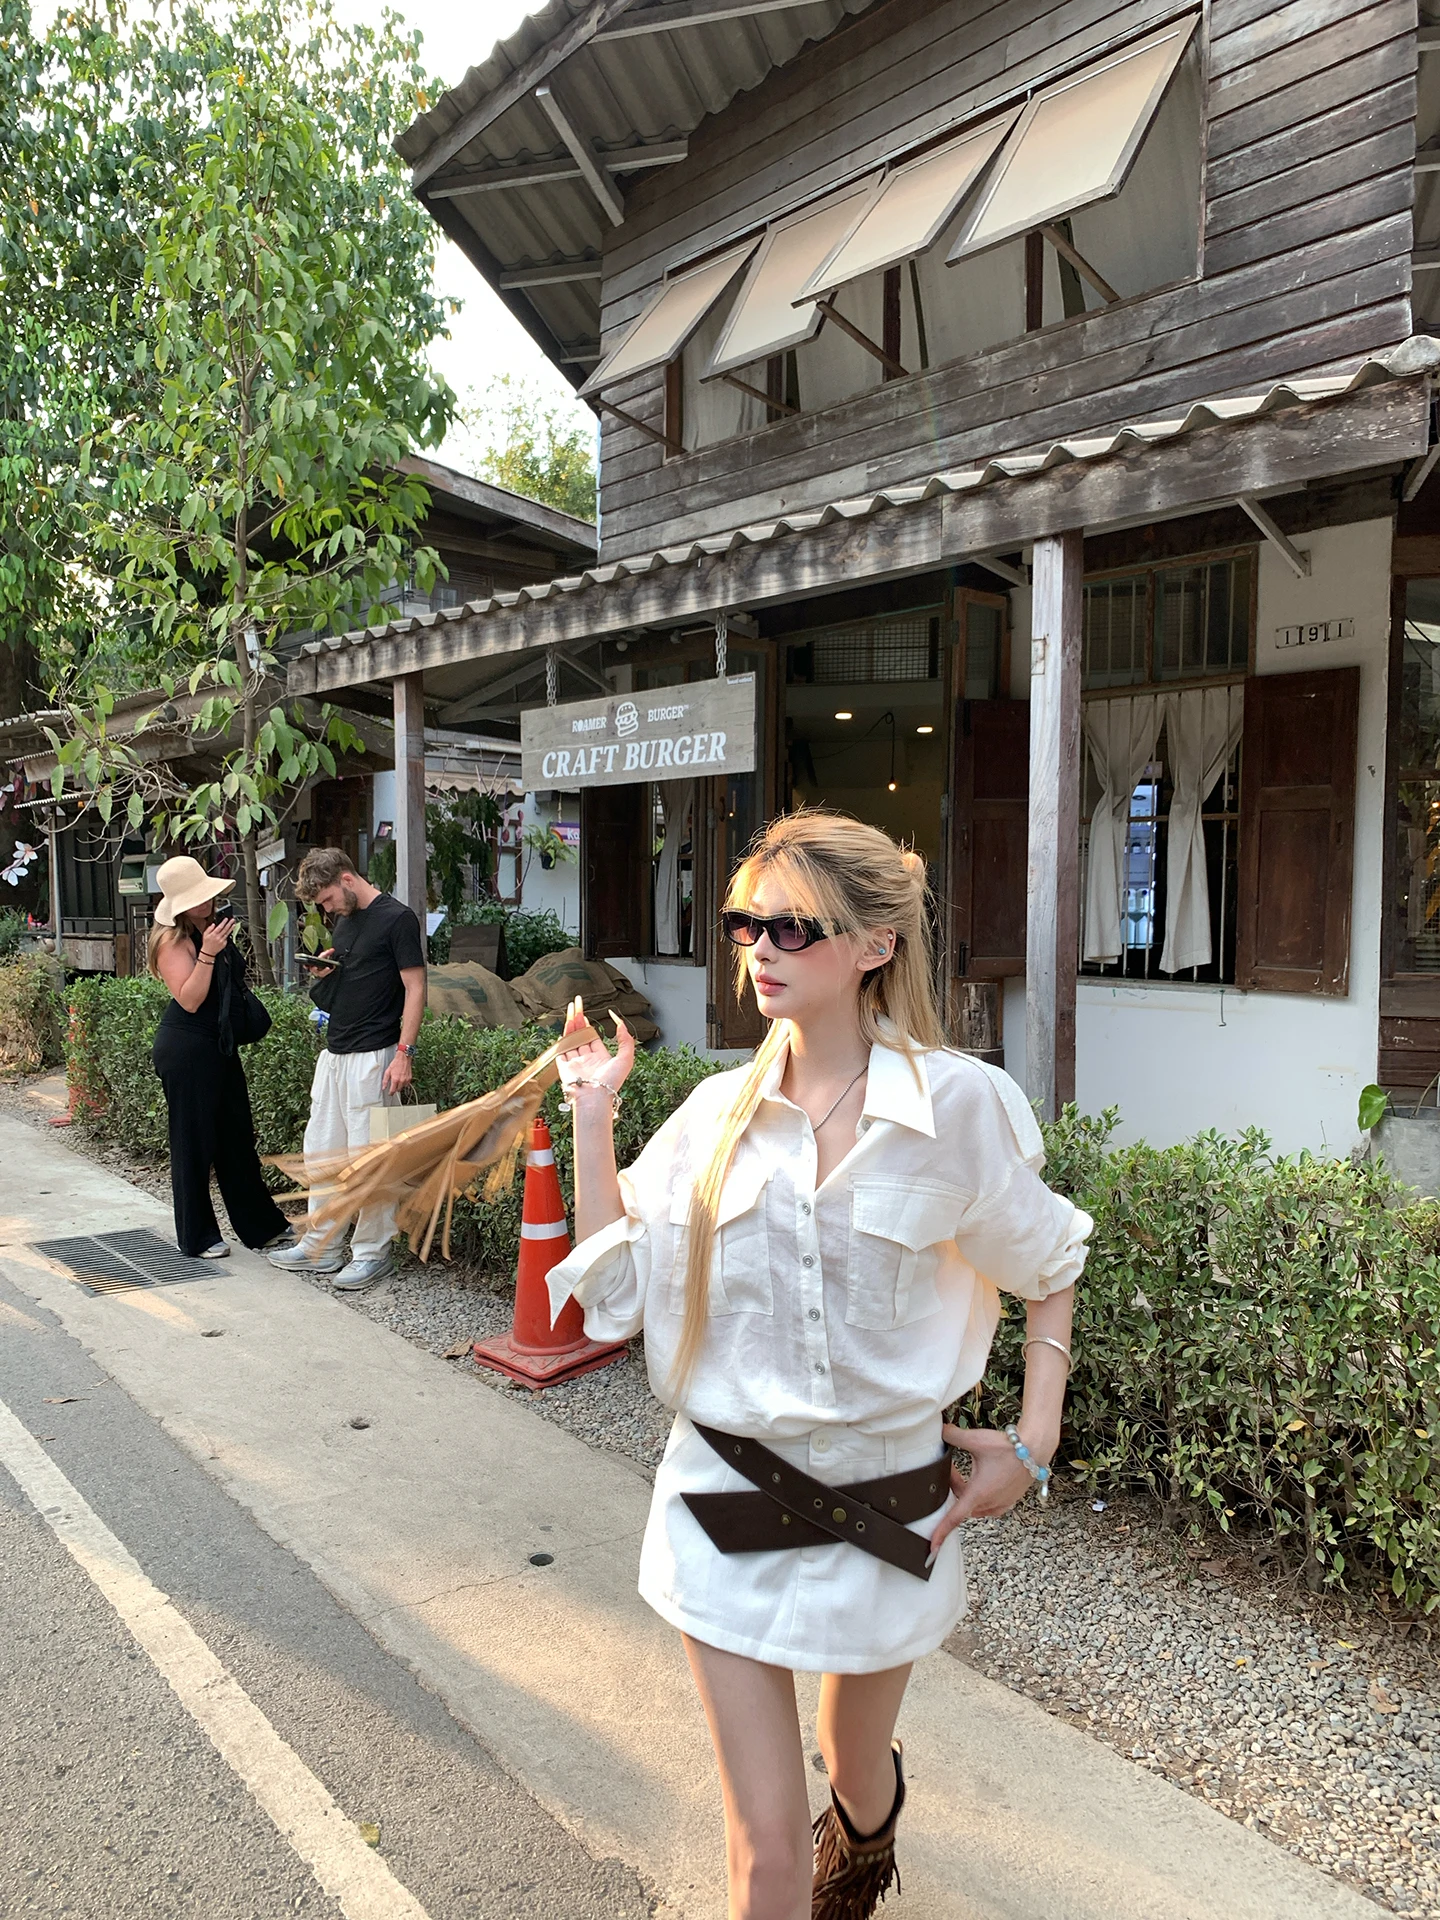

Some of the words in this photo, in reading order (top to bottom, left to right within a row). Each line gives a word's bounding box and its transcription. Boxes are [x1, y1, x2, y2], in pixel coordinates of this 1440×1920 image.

[1285, 623, 1342, 645] 191
[572, 717, 607, 732] ROAMER
[542, 745, 619, 778] CRAFT
[623, 731, 727, 771] BURGER
